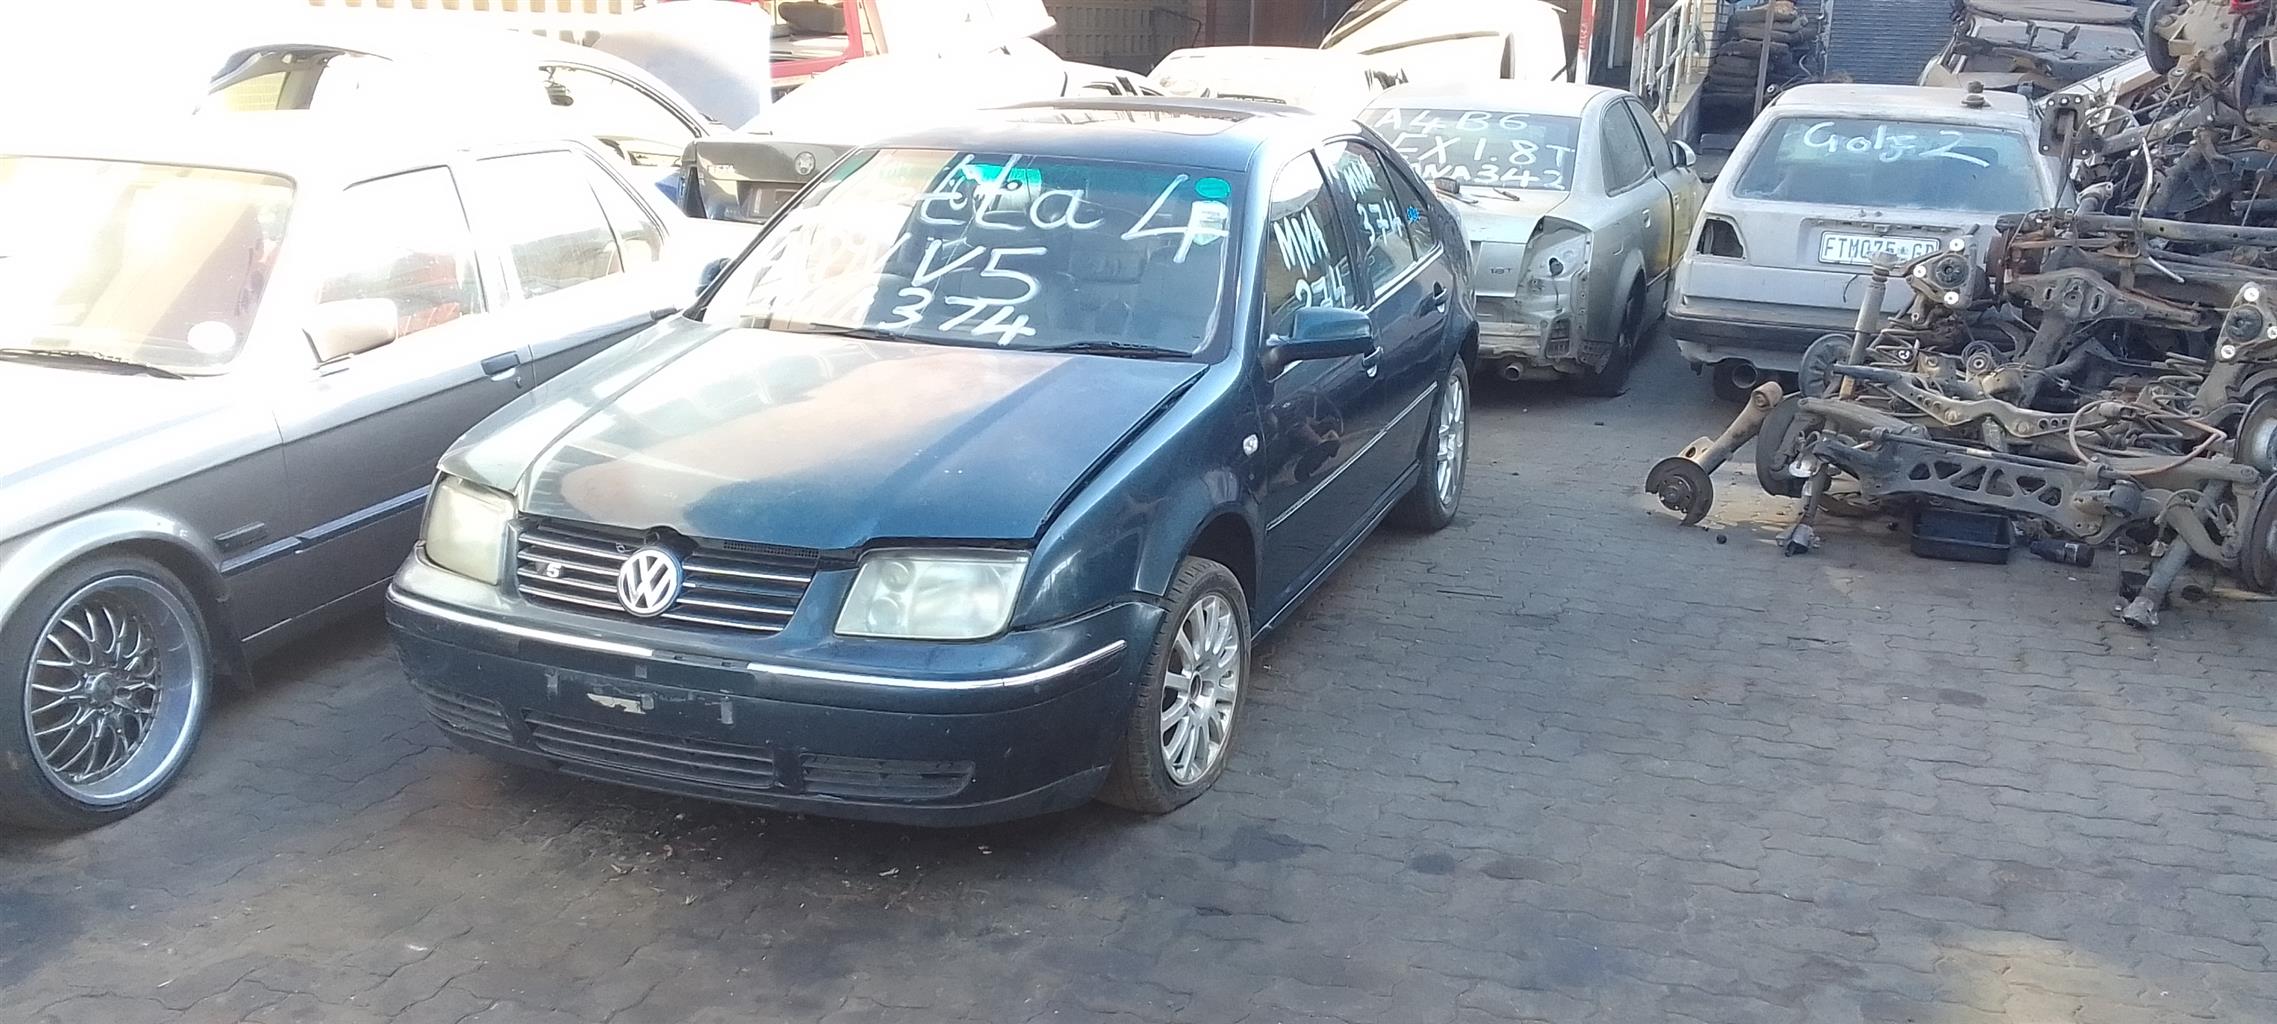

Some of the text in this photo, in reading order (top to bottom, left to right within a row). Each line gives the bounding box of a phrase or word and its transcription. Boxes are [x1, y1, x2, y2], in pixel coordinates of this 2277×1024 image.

[1918, 129, 1990, 168] 2
[1120, 173, 1229, 262] 4
[1356, 197, 1404, 246] 374
[619, 548, 681, 615] VW
